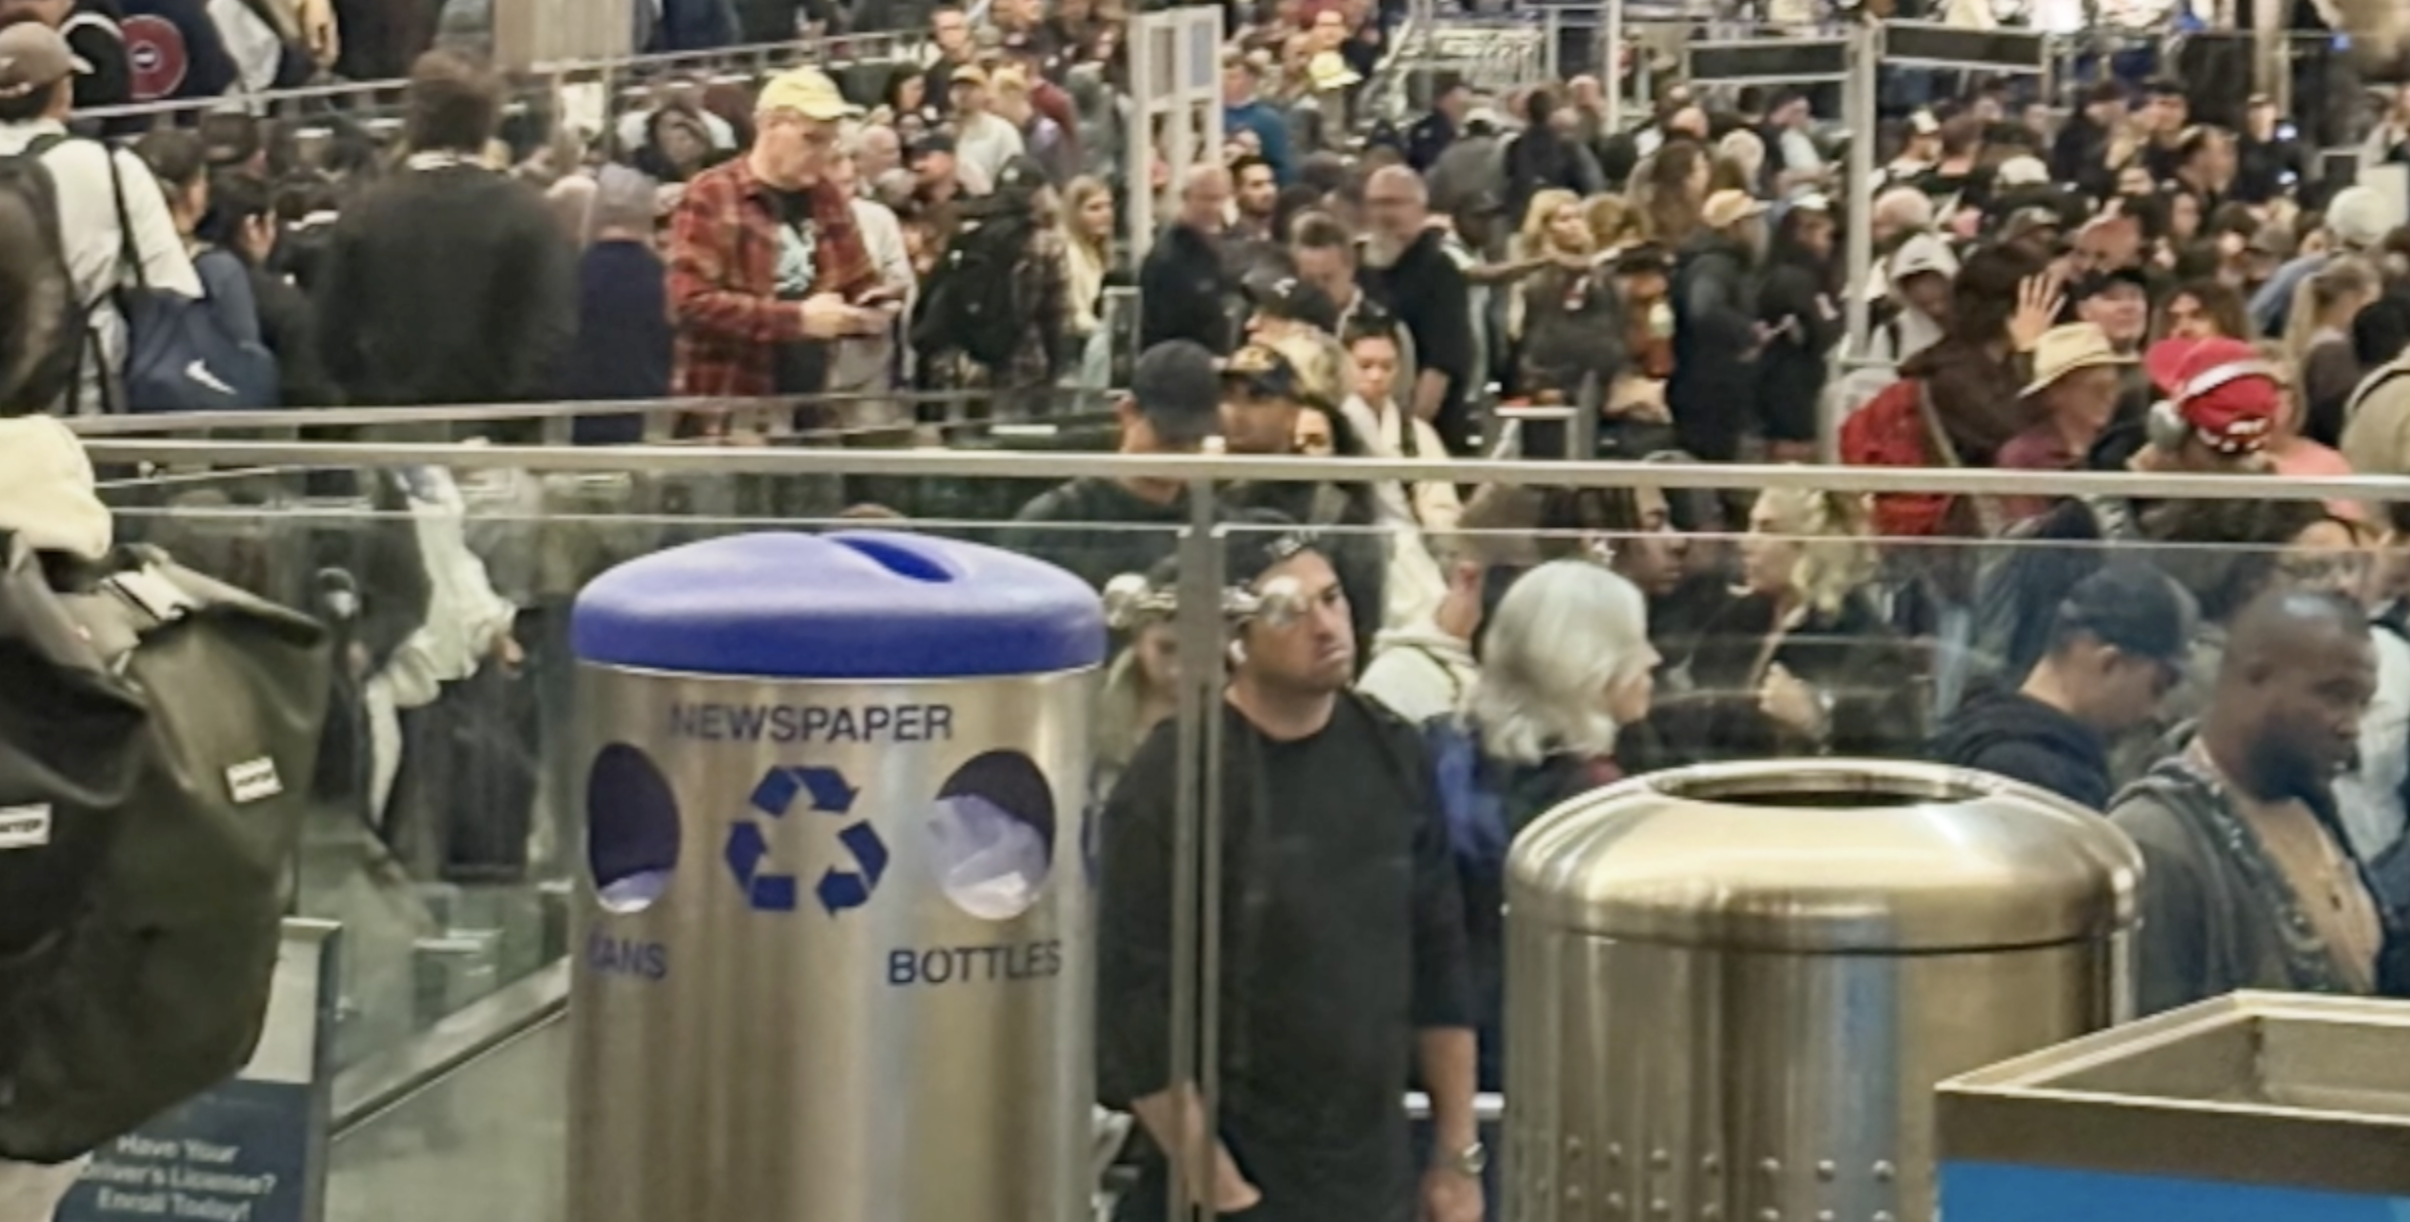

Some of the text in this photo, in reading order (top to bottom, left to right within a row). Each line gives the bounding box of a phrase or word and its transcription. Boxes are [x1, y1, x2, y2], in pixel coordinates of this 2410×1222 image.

[669, 703, 953, 743] NEWSPAPER
[889, 940, 1062, 985] BOTTLES
[117, 1132, 240, 1164] Have Your
[170, 1166, 277, 1195] License?
[97, 1186, 166, 1213] Enroll
